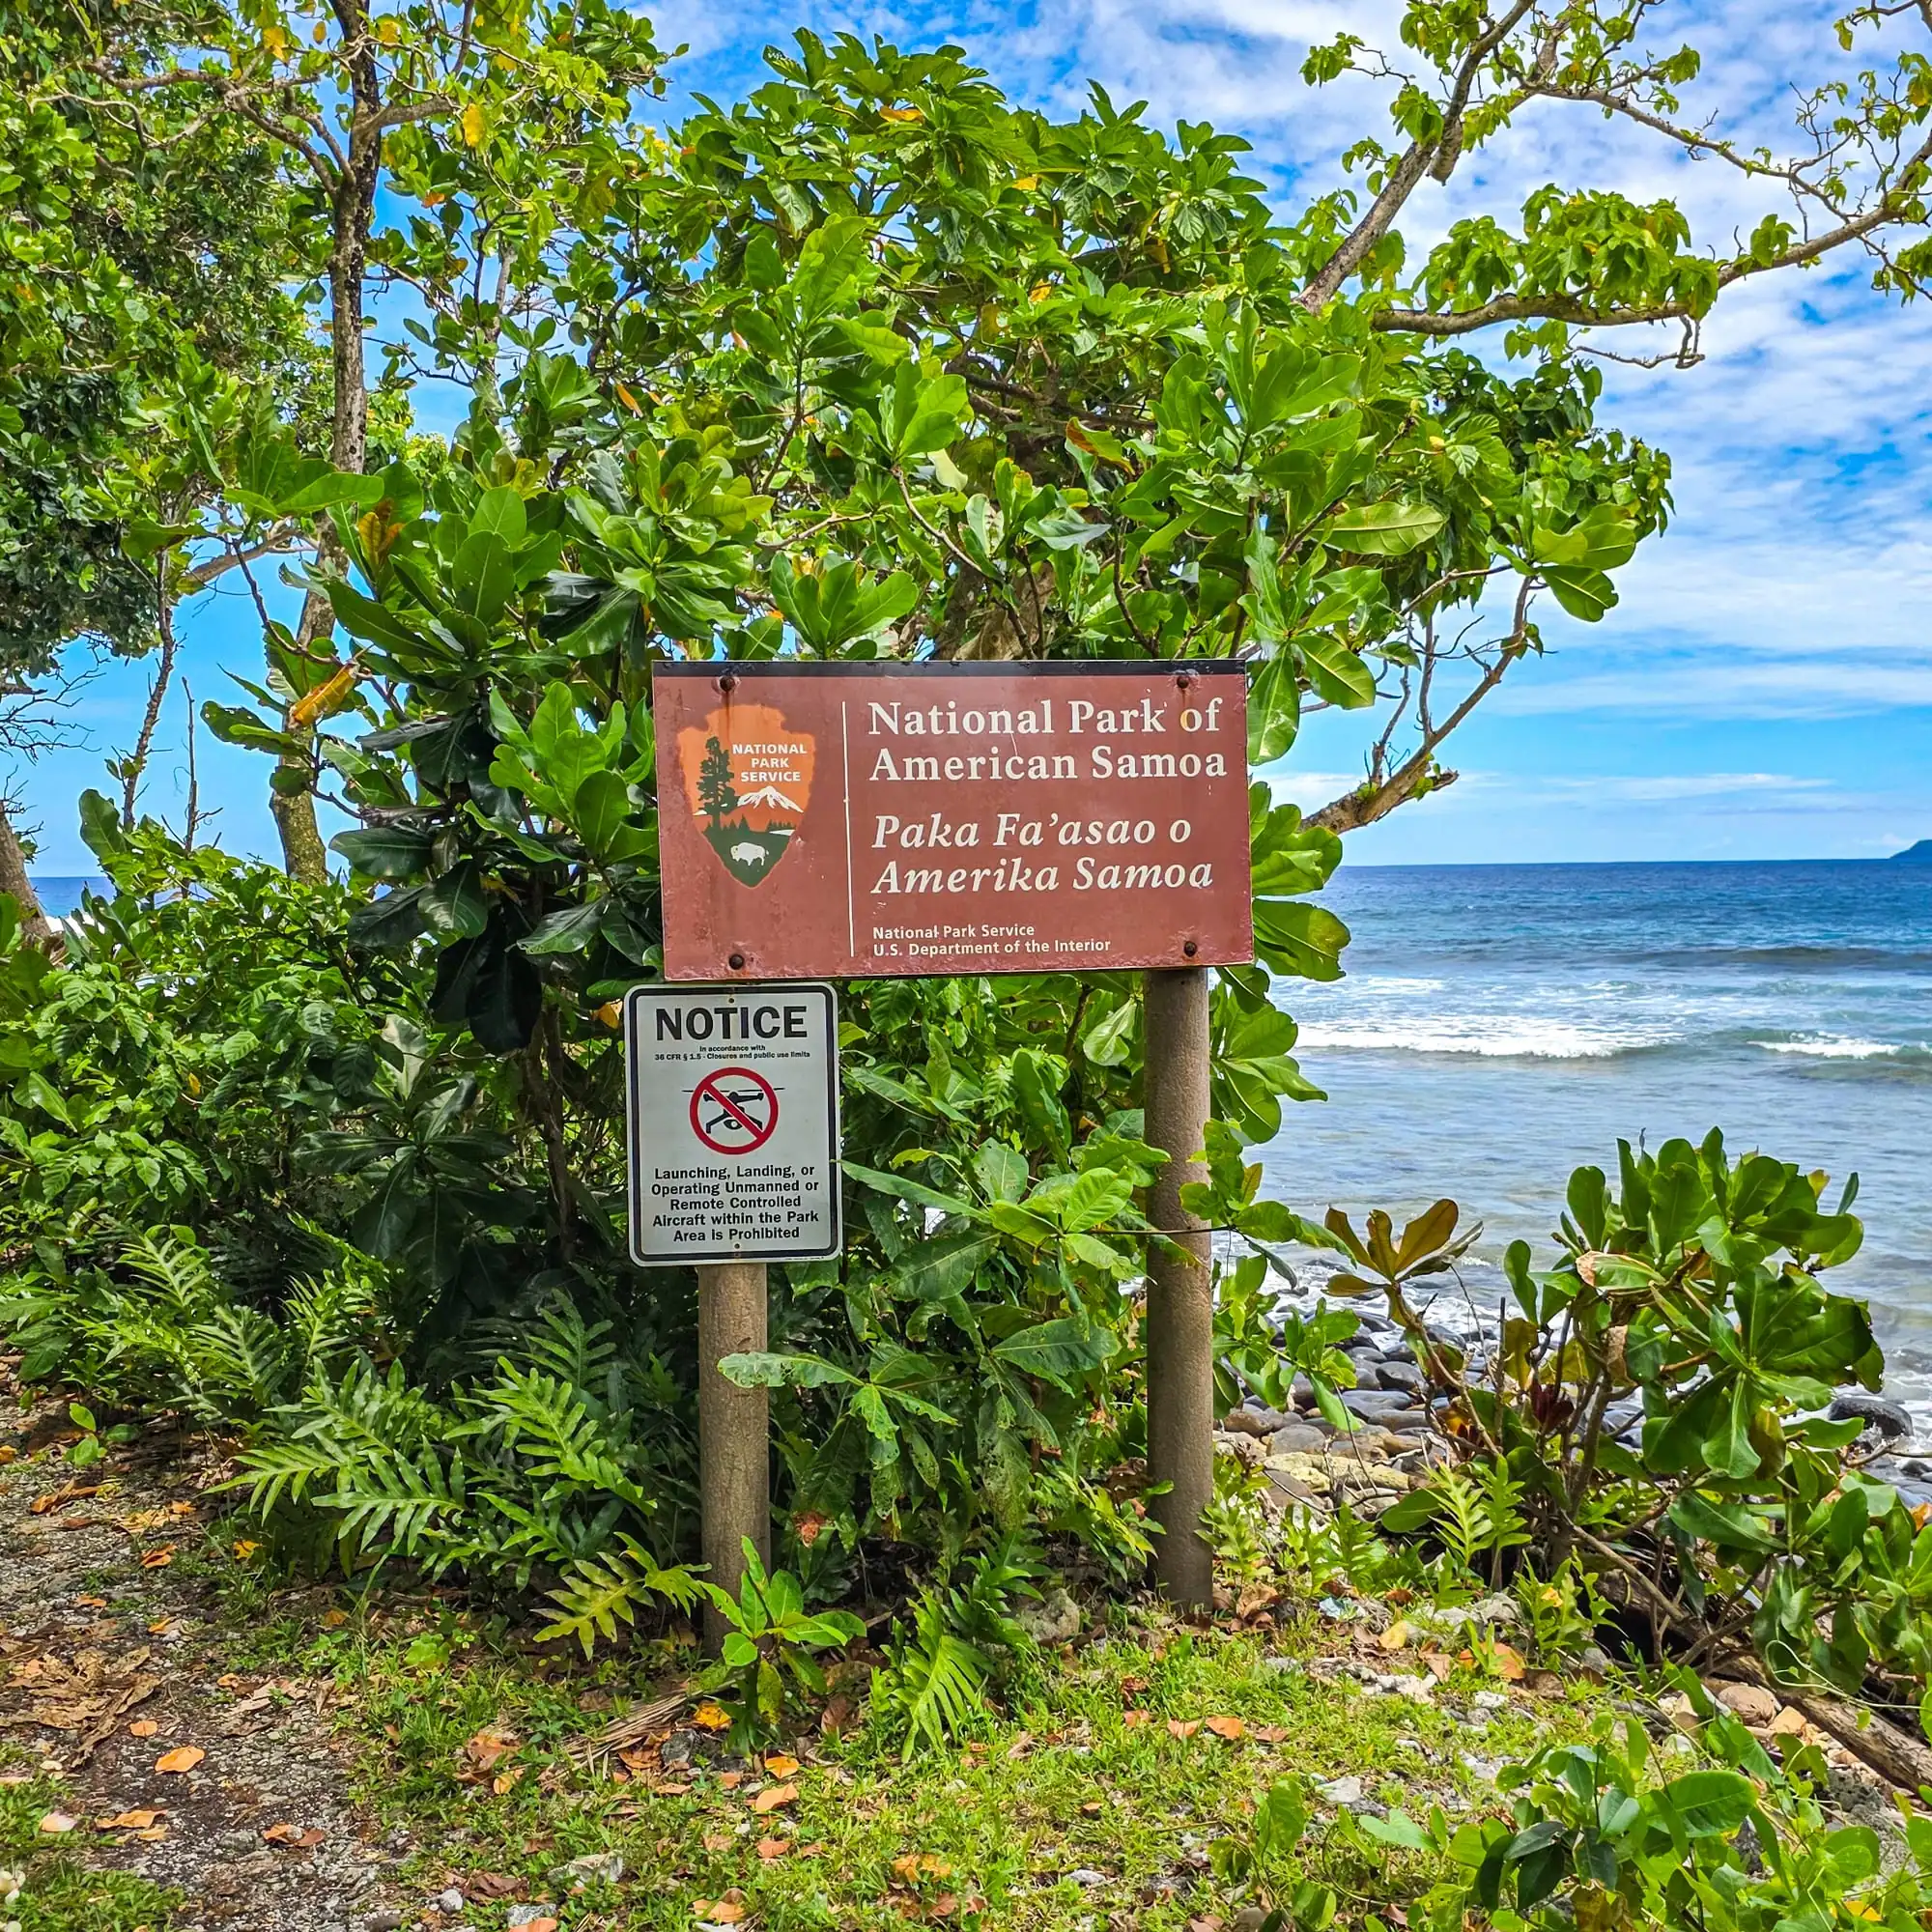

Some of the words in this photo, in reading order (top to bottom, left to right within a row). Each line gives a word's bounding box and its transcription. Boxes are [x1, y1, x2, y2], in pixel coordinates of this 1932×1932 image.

[868, 699, 1054, 735] National
[1068, 698, 1166, 732] Park
[1180, 697, 1222, 731] of
[733, 744, 807, 753] NATIONAL
[752, 757, 788, 768] PARK
[869, 747, 1077, 781] American
[1093, 746, 1227, 778] Samoa
[741, 772, 800, 781] SERVICE
[871, 813, 979, 847] Paka
[993, 813, 1154, 845] Fa’asao
[1170, 820, 1190, 842] o
[870, 857, 1059, 894] Amerika
[1073, 857, 1212, 890] Samoa
[873, 924, 938, 939] National
[944, 924, 976, 937] Park
[981, 923, 1034, 936] Service
[874, 944, 902, 955] U.S.
[913, 941, 1000, 957] Department
[1005, 940, 1020, 952] of
[1026, 940, 1049, 952] the
[1055, 939, 1110, 952] Interior
[656, 1007, 807, 1040] NOTICE
[753, 1051, 775, 1060] public
[790, 1050, 810, 1059] limits
[655, 1166, 730, 1179] Launching,
[737, 1164, 794, 1179] Landing,
[651, 1182, 720, 1196] Operating
[725, 1179, 799, 1193] Unmanned
[670, 1199, 724, 1210] Remote
[730, 1196, 801, 1208] Controlled
[653, 1214, 705, 1227] Aircraft
[711, 1212, 753, 1224] within
[759, 1212, 781, 1223] the
[787, 1210, 818, 1222] Park
[674, 1231, 705, 1241] Area
[712, 1229, 723, 1240] is
[729, 1227, 799, 1239] Prohibited
